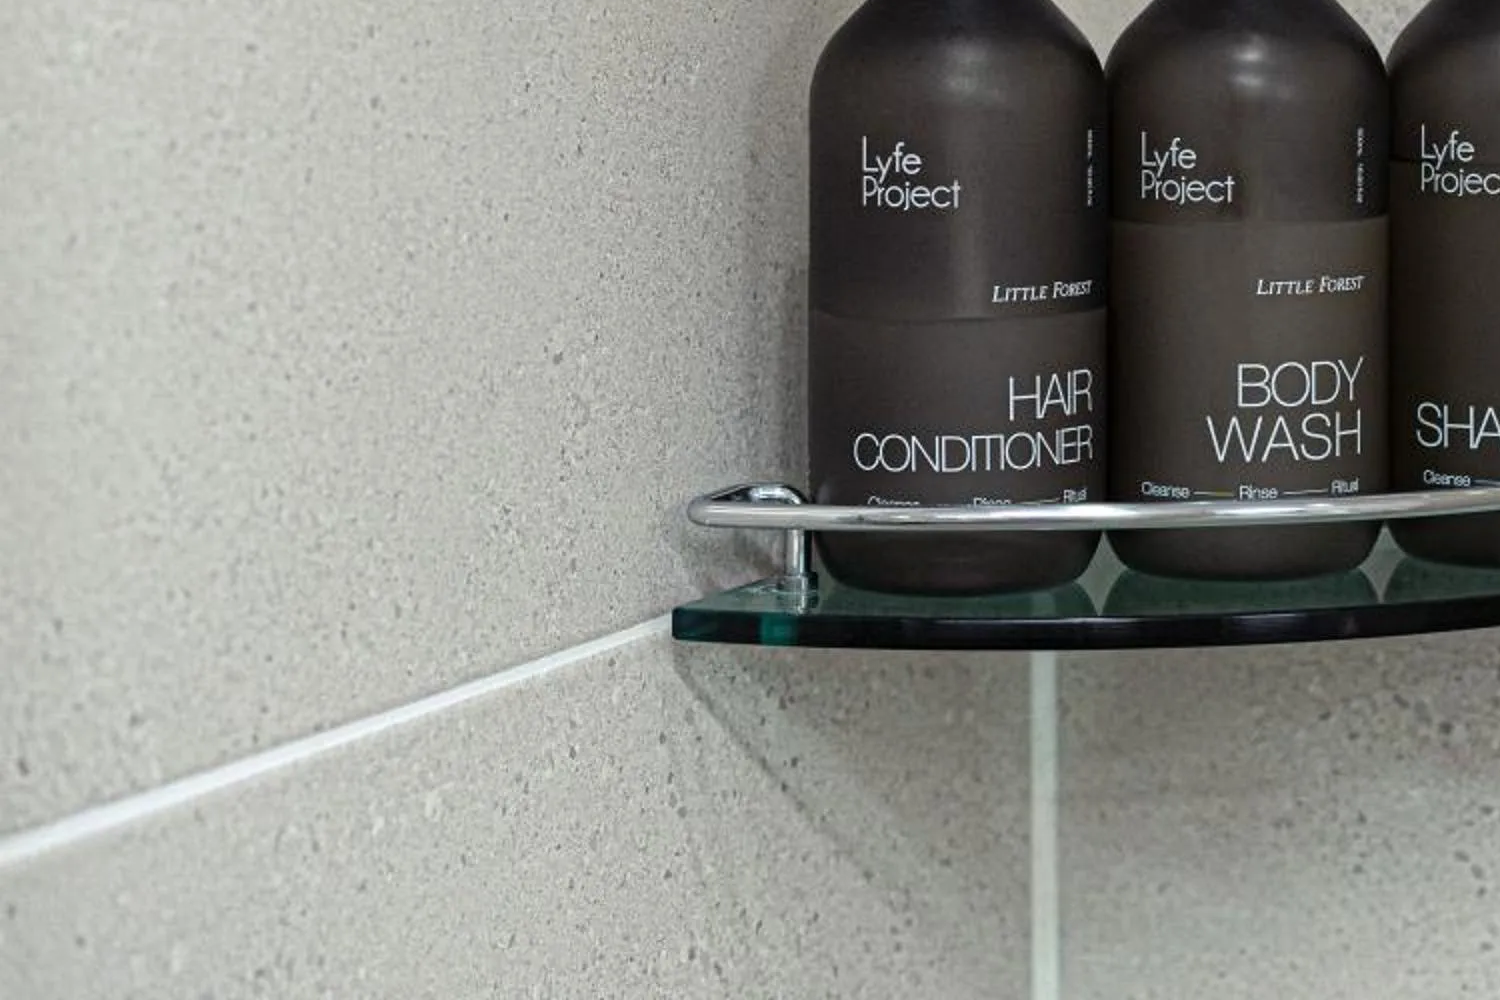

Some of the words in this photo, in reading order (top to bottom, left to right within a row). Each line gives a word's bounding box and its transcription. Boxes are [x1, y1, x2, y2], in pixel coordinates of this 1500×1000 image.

[862, 135, 923, 182] Lyfe
[1141, 131, 1198, 178] Lyfe
[1421, 123, 1476, 170] Lyfe
[862, 175, 962, 211] Project
[1141, 169, 1236, 205] Project
[1008, 368, 1094, 421] HAIR
[1237, 356, 1364, 408] BODY
[853, 424, 1094, 473] CONDITIONER
[1205, 409, 1361, 463] WASH
[1141, 481, 1190, 499] Cleanse
[1239, 483, 1279, 500] Rinse
[1423, 469, 1471, 487] Cleanse
